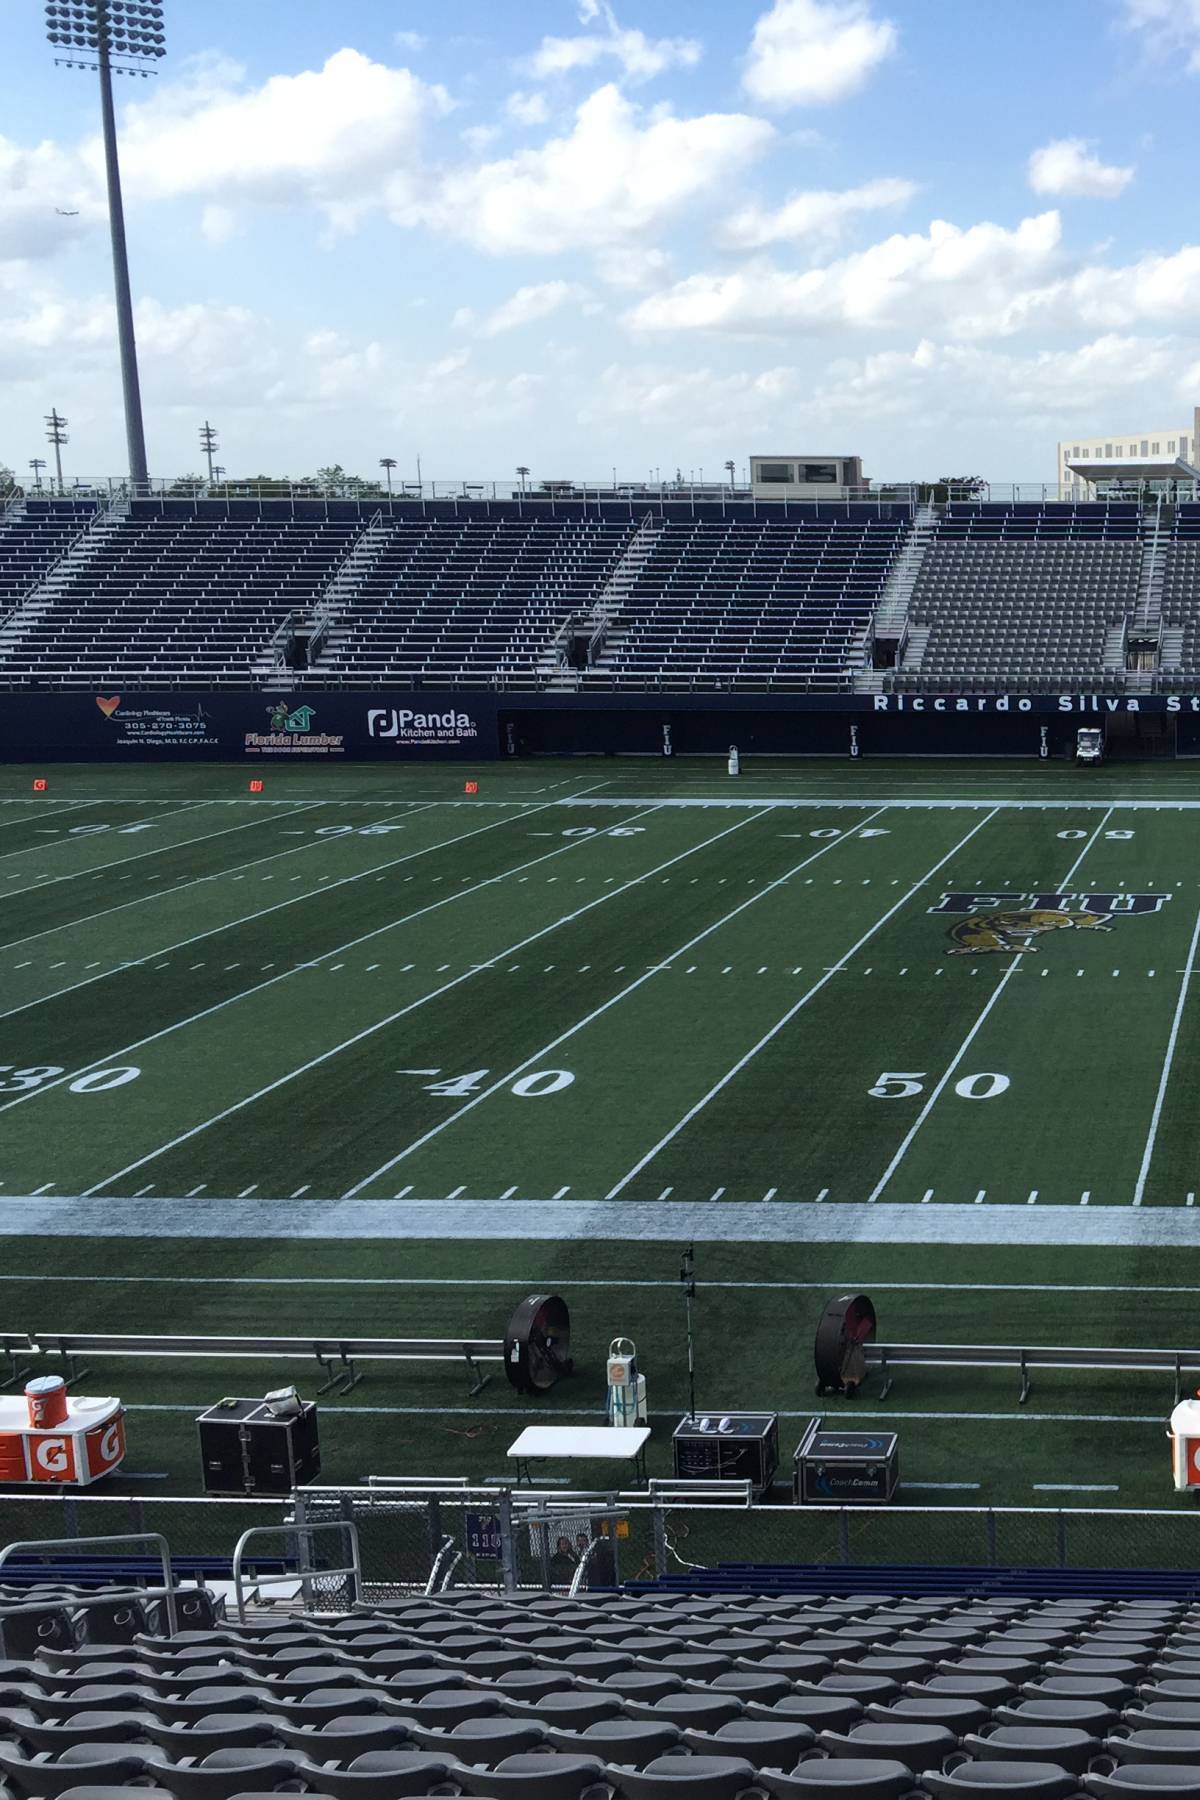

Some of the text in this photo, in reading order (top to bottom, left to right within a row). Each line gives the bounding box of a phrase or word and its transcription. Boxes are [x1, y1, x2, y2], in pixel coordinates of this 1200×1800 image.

[873, 695, 1032, 711] Riccardo
[1058, 695, 1140, 711] Silva
[399, 709, 471, 728] Panda
[245, 732, 344, 746] Florida Lumber
[400, 728, 478, 737] Kitchen and Bath
[926, 892, 1173, 916] FIU
[422, 1069, 576, 1097] 40
[867, 1072, 1011, 1099] 50
[101, 1423, 120, 1461] G
[36, 1438, 68, 1472] G
